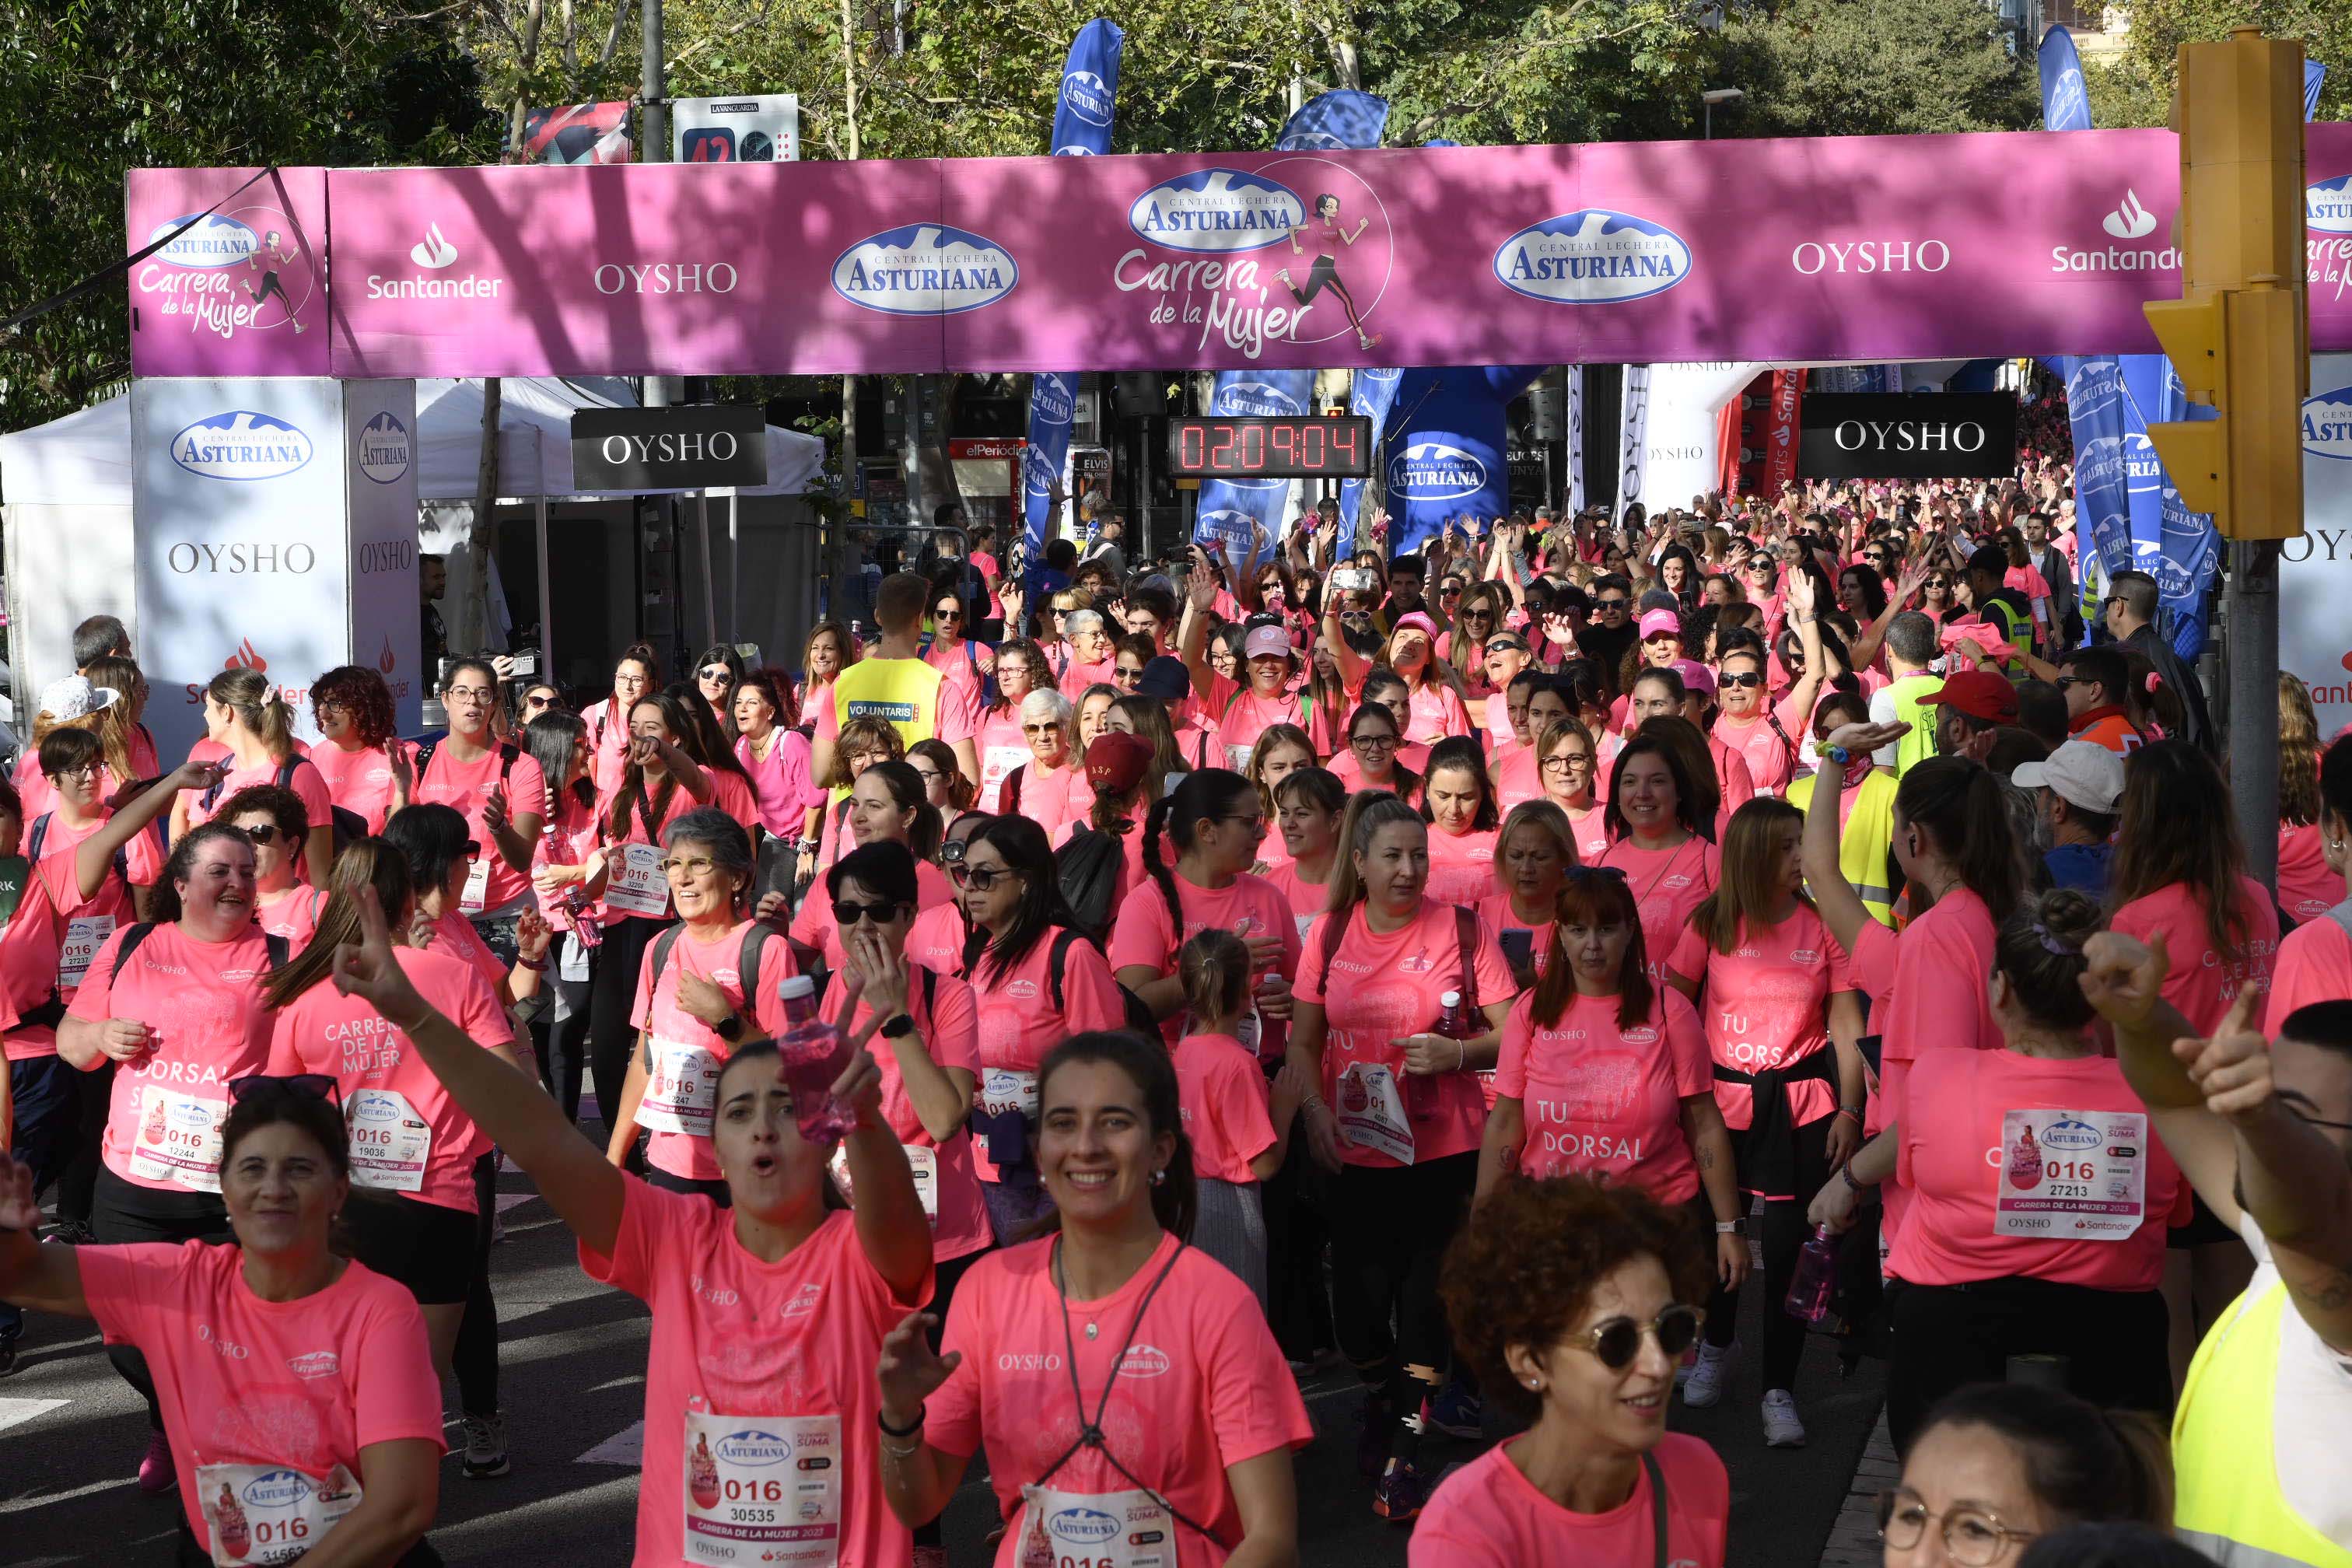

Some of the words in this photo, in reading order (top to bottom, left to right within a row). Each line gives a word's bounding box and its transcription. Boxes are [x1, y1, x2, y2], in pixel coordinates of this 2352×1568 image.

[1066, 80, 1109, 120] ASTURIAN
[1230, 196, 1286, 205] LECHERA
[1143, 201, 1292, 232] ASTURIANA
[158, 232, 250, 254] ASTURIANA
[1538, 243, 1600, 252] CENTRAL
[1607, 241, 1669, 250] LECHERA
[874, 255, 933, 264] CENTRAL
[939, 254, 998, 264] LECHERA
[1509, 246, 1676, 280] ASTURIANA
[1792, 240, 1950, 275] OYSHO
[2052, 244, 2182, 272] Santand
[138, 264, 230, 292] Carrera
[594, 262, 737, 294] OYSHO
[845, 260, 1003, 292] ASTURIANA
[1114, 248, 1259, 292] Carrera
[2324, 261, 2338, 283] la
[367, 274, 502, 299] Santander
[162, 295, 178, 314] de
[181, 295, 194, 314] la
[192, 291, 265, 339] Mujer
[1150, 294, 1176, 324] de
[1182, 293, 1202, 324] la
[1198, 285, 1314, 359] Mujer
[1624, 364, 1647, 502] OYSH
[1834, 420, 1985, 453] OYSHO
[183, 437, 303, 464] ASTURIANA
[362, 439, 408, 466] ASTURIANA
[603, 431, 737, 464] OYSHO
[1181, 425, 1355, 468] 02:09:04
[1084, 459, 1108, 469] ELVIS
[1391, 467, 1479, 488] ASTURIANA
[168, 542, 315, 574] OYSHO
[360, 540, 411, 574] OYSHO
[849, 705, 911, 717] VOLUNTARIS
[628, 869, 649, 880] 016
[65, 943, 91, 956] 016
[145, 959, 187, 975] OYSHO
[1335, 959, 1373, 974] OYSHO
[324, 1017, 401, 1041] CARRER
[1721, 1013, 1748, 1034] TU
[342, 1037, 368, 1056] DE
[373, 1033, 397, 1051] LA
[1542, 1029, 1587, 1041] OYSHO
[341, 1050, 401, 1075] MUJER
[133, 1059, 230, 1087] DORSAL
[667, 1078, 695, 1094] 016
[358, 1105, 397, 1118] ASTURIANA
[989, 1101, 1020, 1116] 016
[1537, 1099, 1567, 1123] TU
[168, 1129, 202, 1148] 016
[356, 1128, 392, 1145] 016
[2045, 1132, 2098, 1145] ASTURIANA
[2108, 1129, 2136, 1138] SUMA
[169, 1146, 194, 1159] 12244
[359, 1146, 386, 1157] 19036
[1543, 1132, 1643, 1161] DORSAL
[380, 1173, 415, 1183] Santander
[2046, 1160, 2095, 1181] 016
[2050, 1185, 2088, 1197] 27213
[2014, 1201, 2051, 1209] CARRERA
[2109, 1204, 2130, 1213] 2023
[2008, 1218, 2051, 1229] OYSHO
[2087, 1220, 2132, 1231] Santander
[999, 1353, 1060, 1371] OYSHO
[721, 1443, 785, 1458] ASTURIANA
[797, 1439, 830, 1447] SUMA
[249, 1485, 306, 1501] ASTURIANA
[725, 1479, 782, 1501] 016
[730, 1507, 775, 1522] 30535
[255, 1517, 309, 1543] 016
[697, 1521, 733, 1536] CARRERA
[735, 1528, 747, 1538] DE
[749, 1529, 762, 1538] LA
[764, 1529, 799, 1538] MUJER
[802, 1528, 824, 1538] 2023
[1055, 1519, 1115, 1535] ASTURIANA
[696, 1541, 736, 1559] OYSHO
[775, 1549, 827, 1562] Santander
